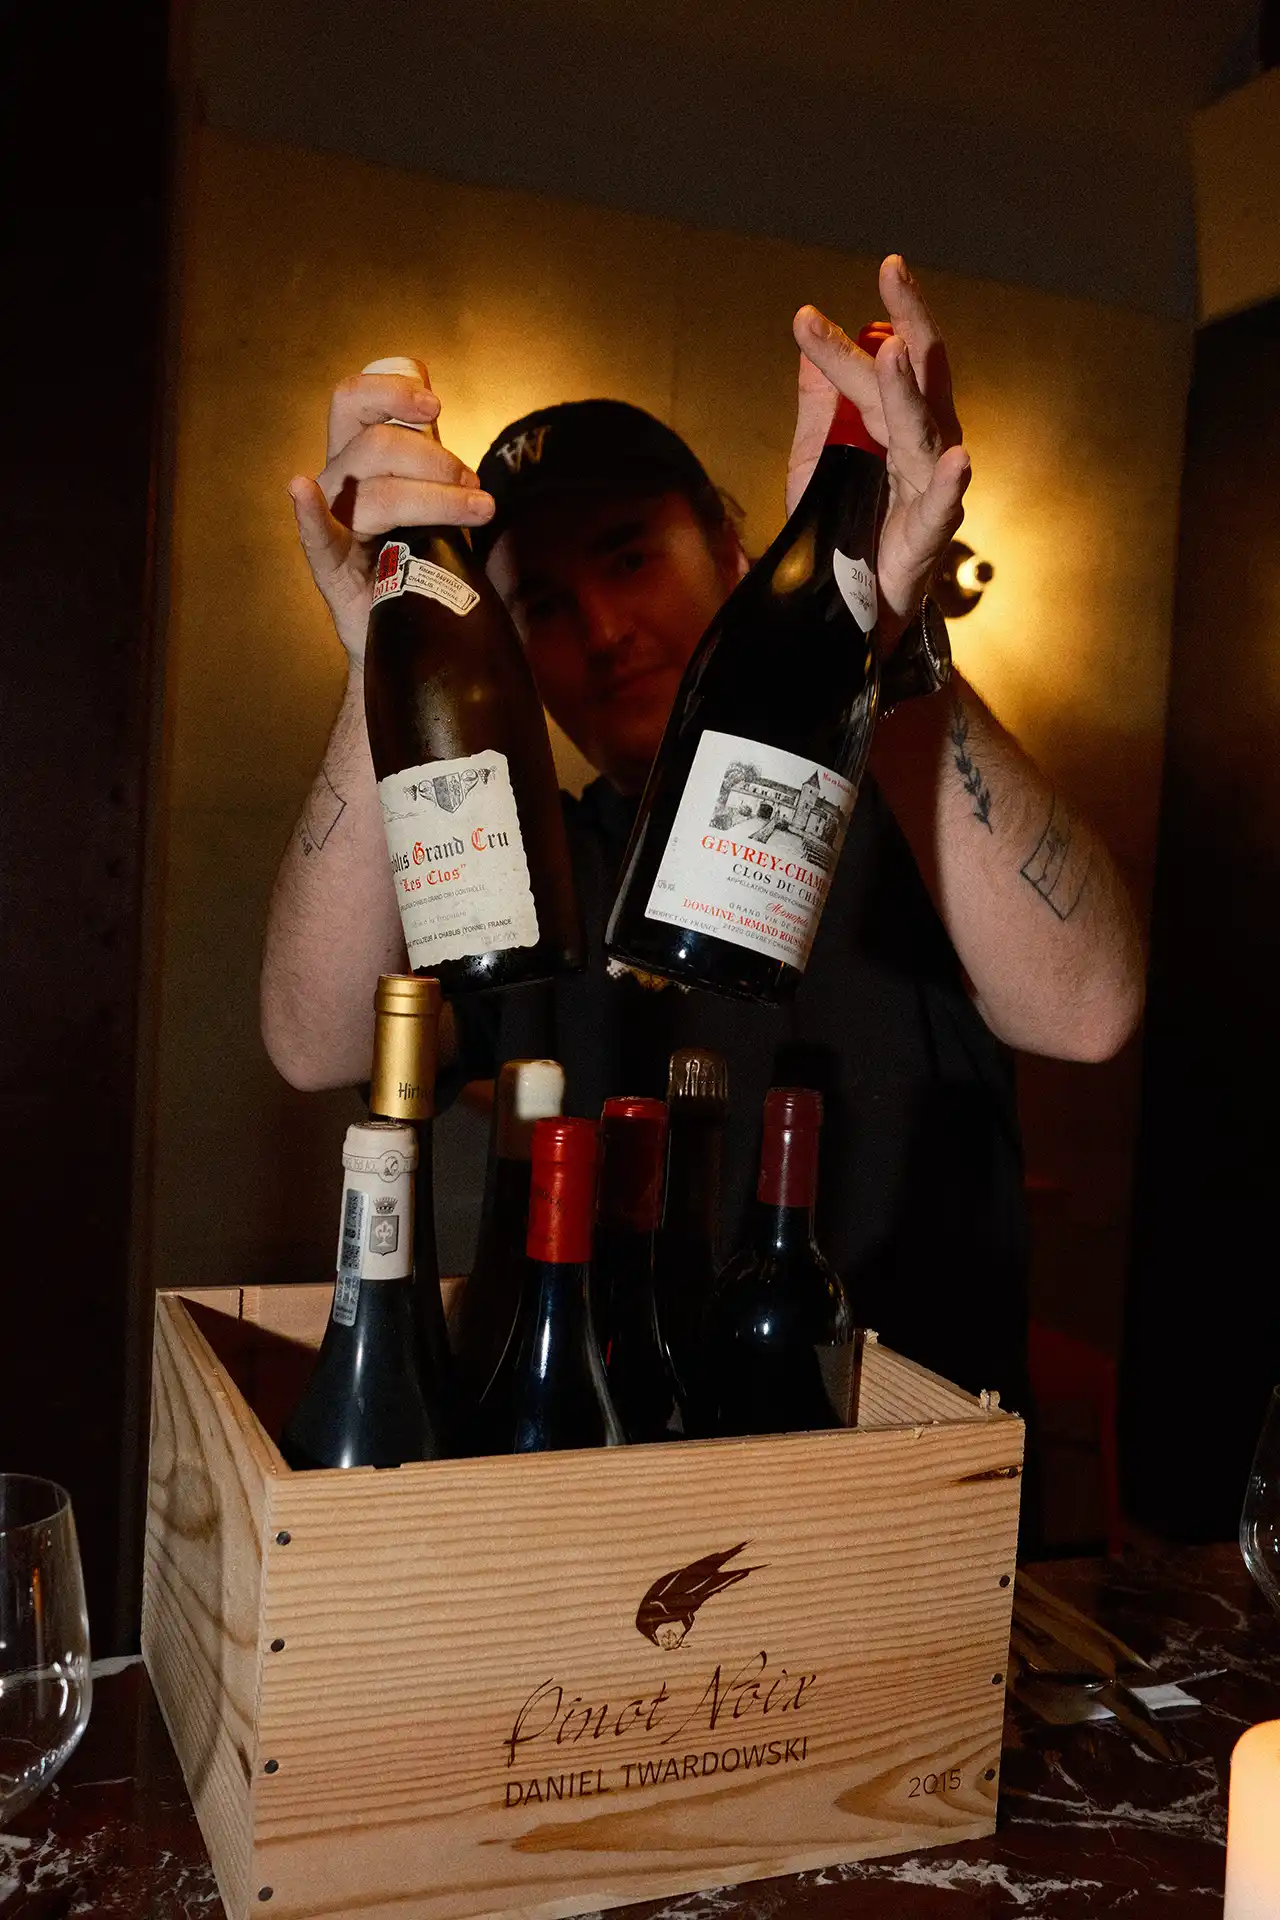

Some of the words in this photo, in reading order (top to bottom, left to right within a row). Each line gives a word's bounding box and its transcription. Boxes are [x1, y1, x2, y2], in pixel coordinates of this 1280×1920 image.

[408, 575, 434, 588] CHABLIS
[412, 837, 465, 866] Grand
[471, 827, 510, 852] Cru
[727, 875, 769, 896] APPELLATION
[732, 863, 771, 885] CLOS
[777, 879, 796, 894] DU
[682, 897, 734, 923] DOMAINE
[736, 917, 778, 938] ARMAND
[690, 918, 719, 933] FRANCE
[729, 901, 761, 918] GRAND
[764, 914, 781, 926] VIN
[438, 928, 461, 941] CHABLIS
[487, 918, 513, 930] FRANCE
[503, 1677, 670, 1768] Pinot
[504, 1769, 611, 1809] DANIEL
[624, 1736, 810, 1788] TWARDOWSKI
[908, 1768, 962, 1800] 2015
